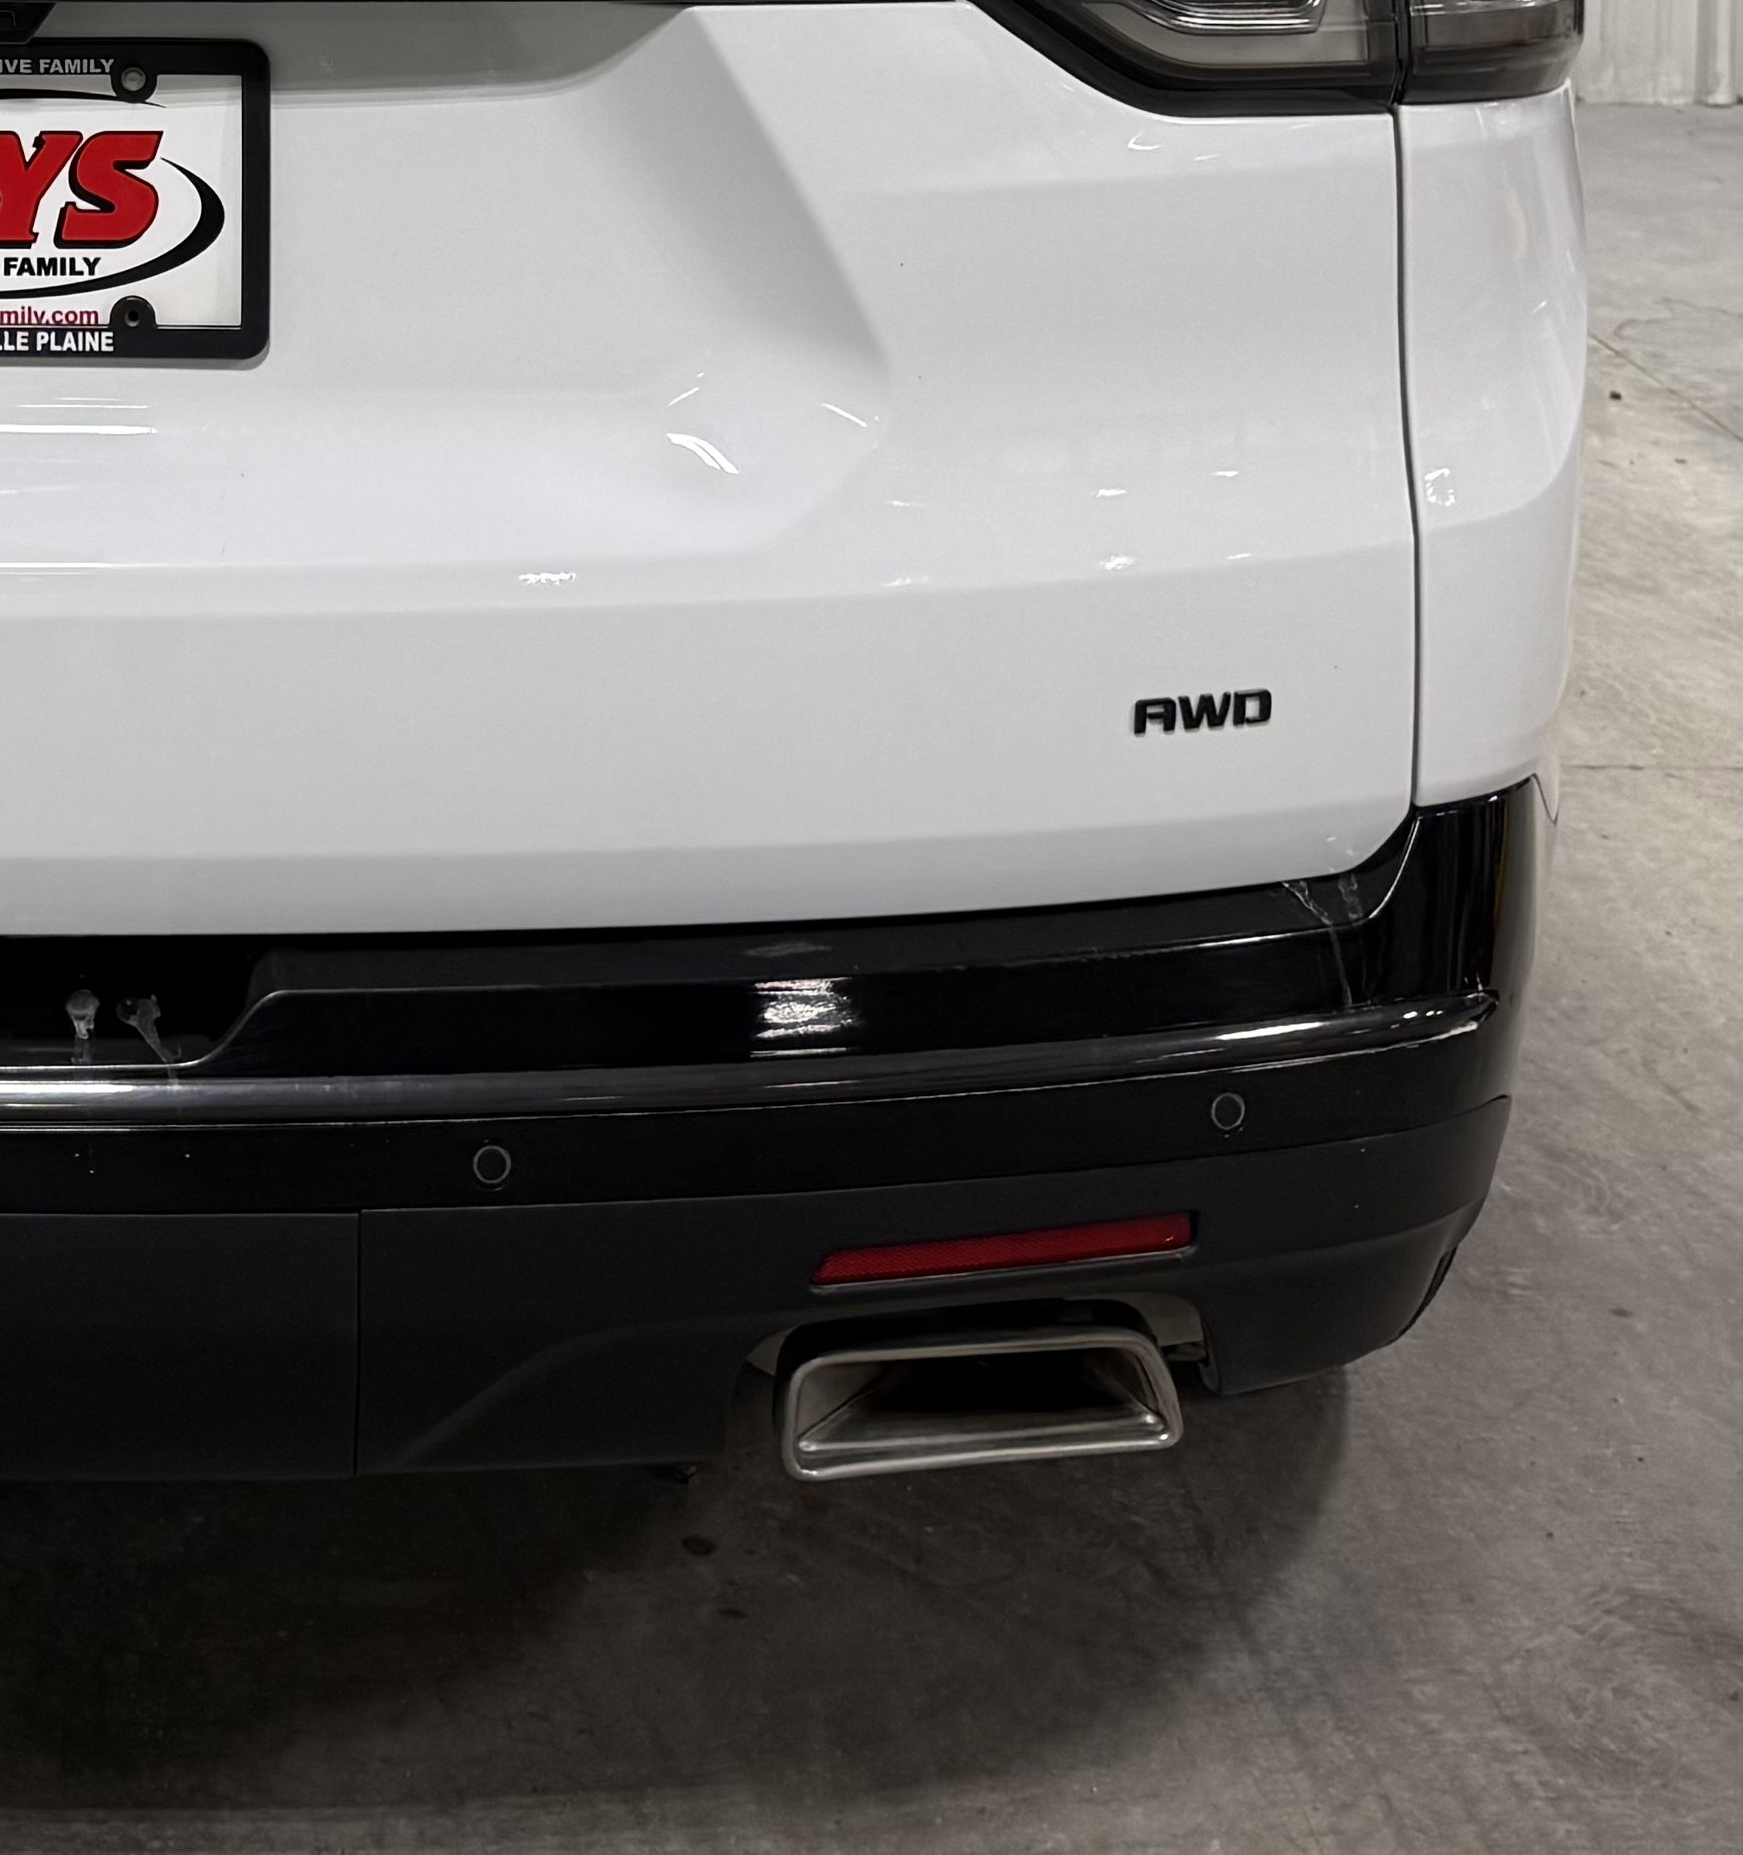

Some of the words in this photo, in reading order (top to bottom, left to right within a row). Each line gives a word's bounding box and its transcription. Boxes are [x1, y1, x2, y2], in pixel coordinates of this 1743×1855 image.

[39, 58, 115, 74] FAMILY
[3, 256, 101, 277] FAMILY
[36, 331, 114, 352] PLAINE
[1134, 688, 1272, 735] AWD
